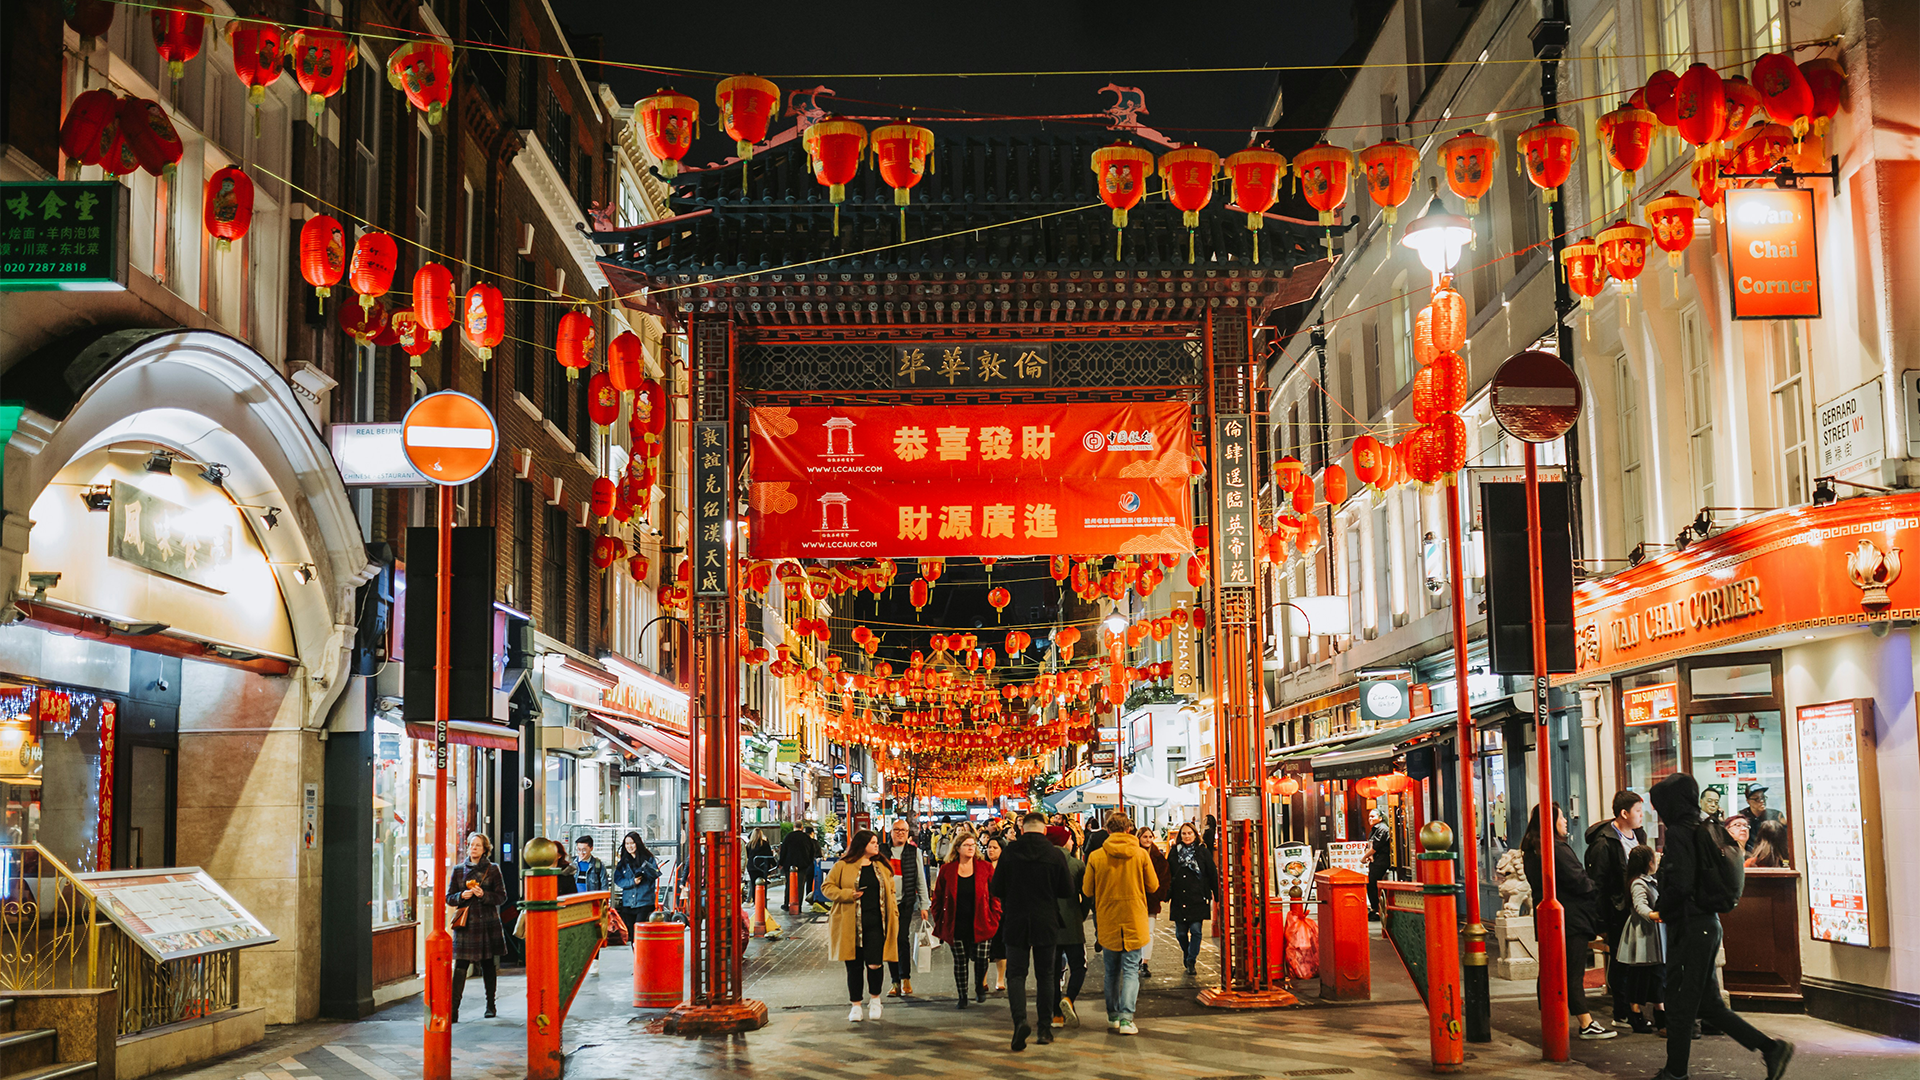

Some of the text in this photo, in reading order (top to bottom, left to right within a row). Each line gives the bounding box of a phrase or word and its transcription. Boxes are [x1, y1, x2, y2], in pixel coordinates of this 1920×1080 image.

[1749, 240, 1798, 258] Chai
[4, 262, 87, 272] 020 7287 2818
[1738, 276, 1812, 294] Corner
[1822, 398, 1857, 427] GERRARD
[893, 425, 1055, 462] 恭喜發財
[1823, 415, 1864, 446] STREET W1
[807, 465, 883, 473] WWW.LCCAUK.COM
[897, 503, 1058, 541] 財源廣進
[1609, 576, 1763, 650] WAN CHAI CORNER
[1176, 599, 1190, 670] HOZHAN
